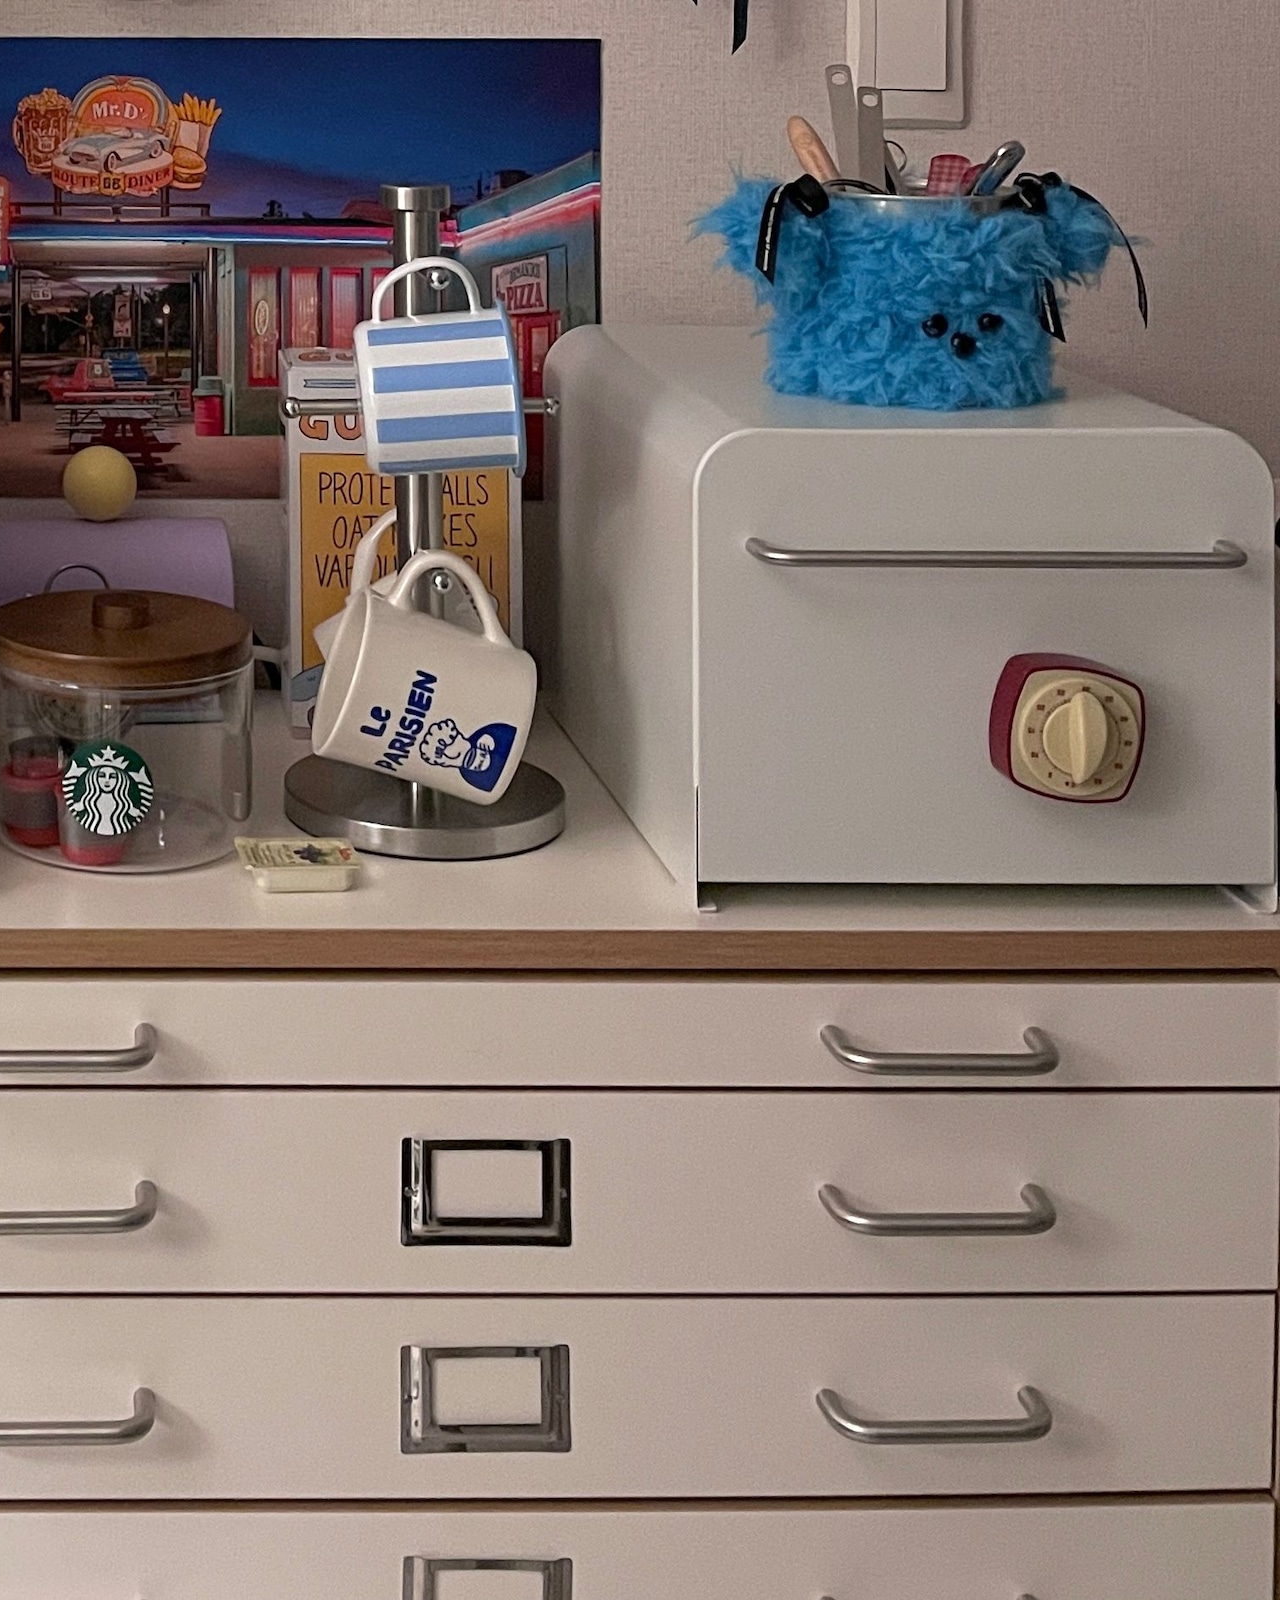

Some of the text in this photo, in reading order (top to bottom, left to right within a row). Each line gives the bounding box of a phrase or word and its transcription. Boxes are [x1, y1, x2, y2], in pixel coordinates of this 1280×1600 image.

[92, 101, 120, 119] Mr.
[54, 169, 98, 189] ROUTE
[127, 170, 170, 188] DINER
[507, 282, 544, 311] PIZZA
[360, 705, 391, 737] Le
[374, 670, 438, 772] PARISIEN
